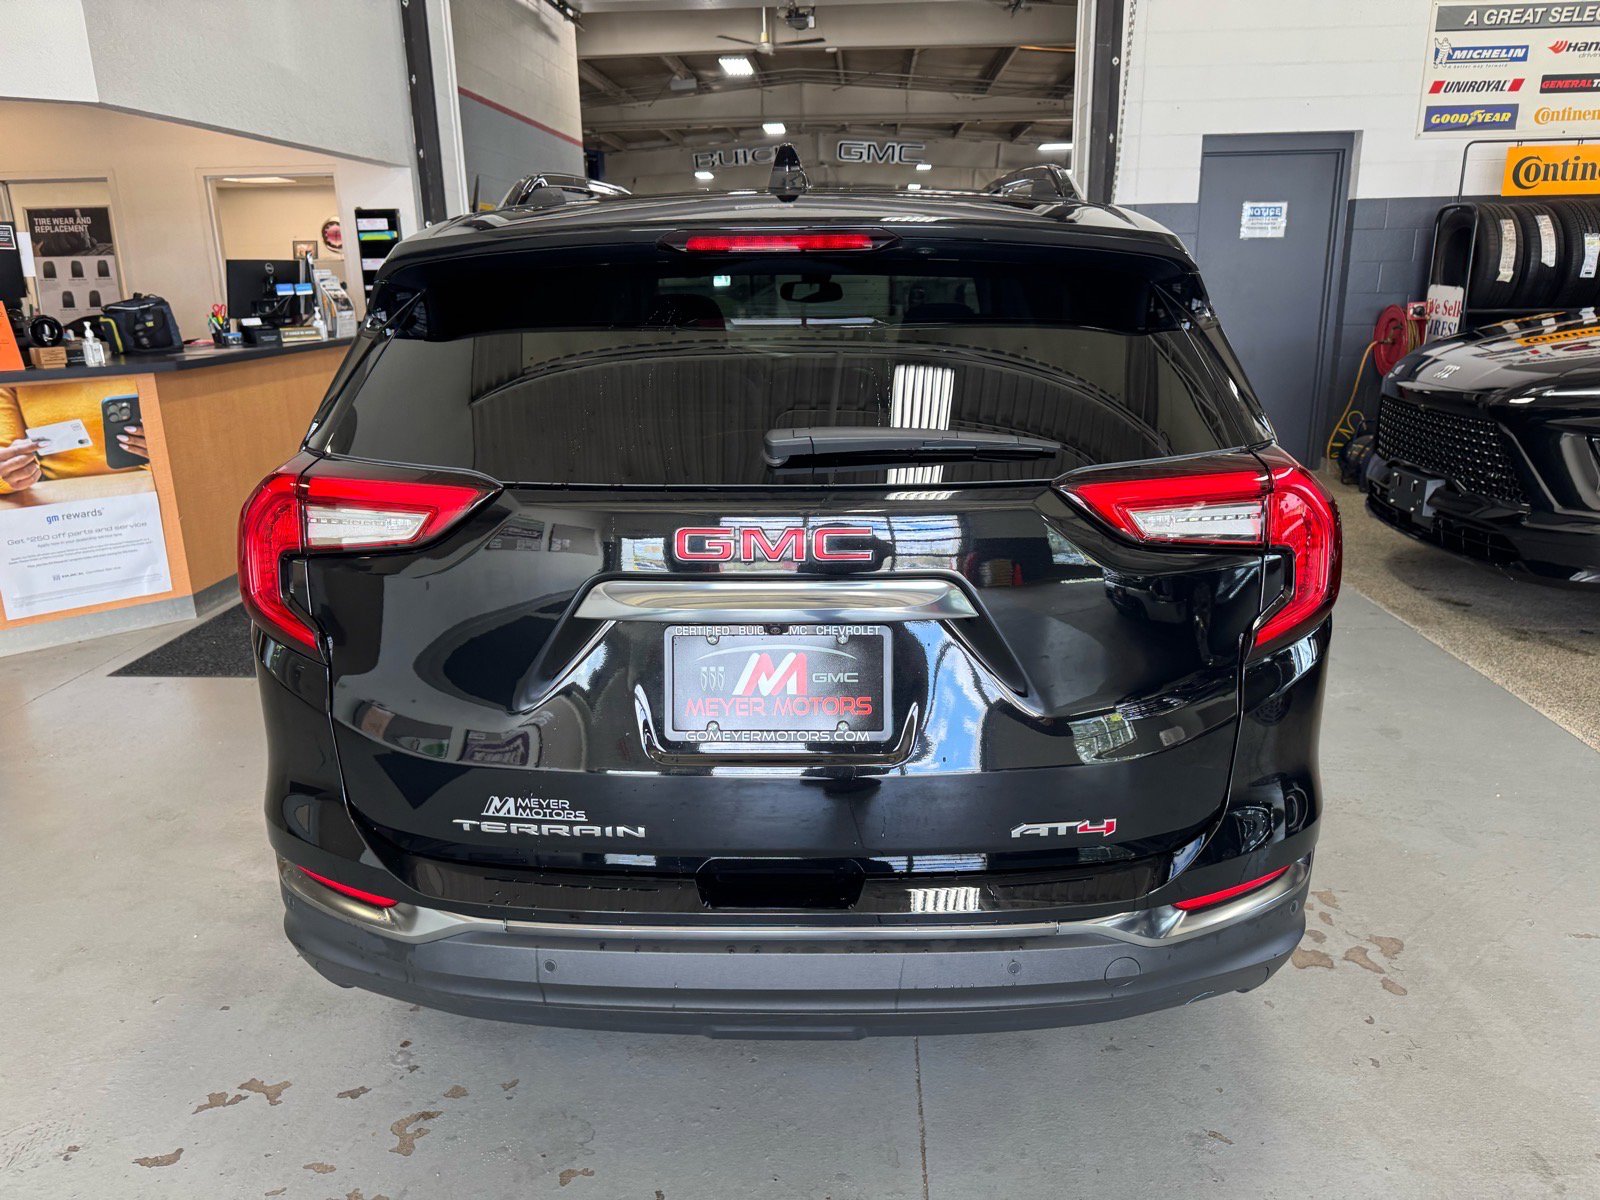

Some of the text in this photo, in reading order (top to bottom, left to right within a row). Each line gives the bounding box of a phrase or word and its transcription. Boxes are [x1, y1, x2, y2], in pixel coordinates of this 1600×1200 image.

[1464, 9, 1478, 26] A
[1483, 7, 1548, 25] GREAT
[1565, 41, 1600, 52] Han
[1452, 48, 1527, 60] MICHELIN
[1443, 80, 1507, 93] UNIROYAL
[1430, 110, 1512, 125] GOODYEAR
[837, 140, 925, 165] GMC
[1511, 155, 1600, 190] Contin
[1248, 207, 1282, 217] NOTICE
[33, 216, 92, 226] TIRE WEAR AND
[34, 224, 89, 234] REPLACEMENT
[1441, 299, 1461, 318] Sell
[46, 508, 103, 525] gm rewards
[7, 538, 25, 546] Get
[51, 531, 66, 540] off
[67, 528, 93, 539] parts
[94, 525, 113, 534] and
[674, 526, 875, 563] GMC
[674, 625, 881, 636] CERTIFIED BUIC MC CHEVROLET
[811, 672, 859, 683] GMC
[684, 696, 873, 717] MEYER MOTORS
[685, 730, 870, 742] GOMEYERMOTORS.COM
[516, 797, 570, 809] MEYER
[517, 807, 587, 820] MOTORS
[452, 818, 646, 838] TERRAIN
[1010, 818, 1117, 838] AT4
